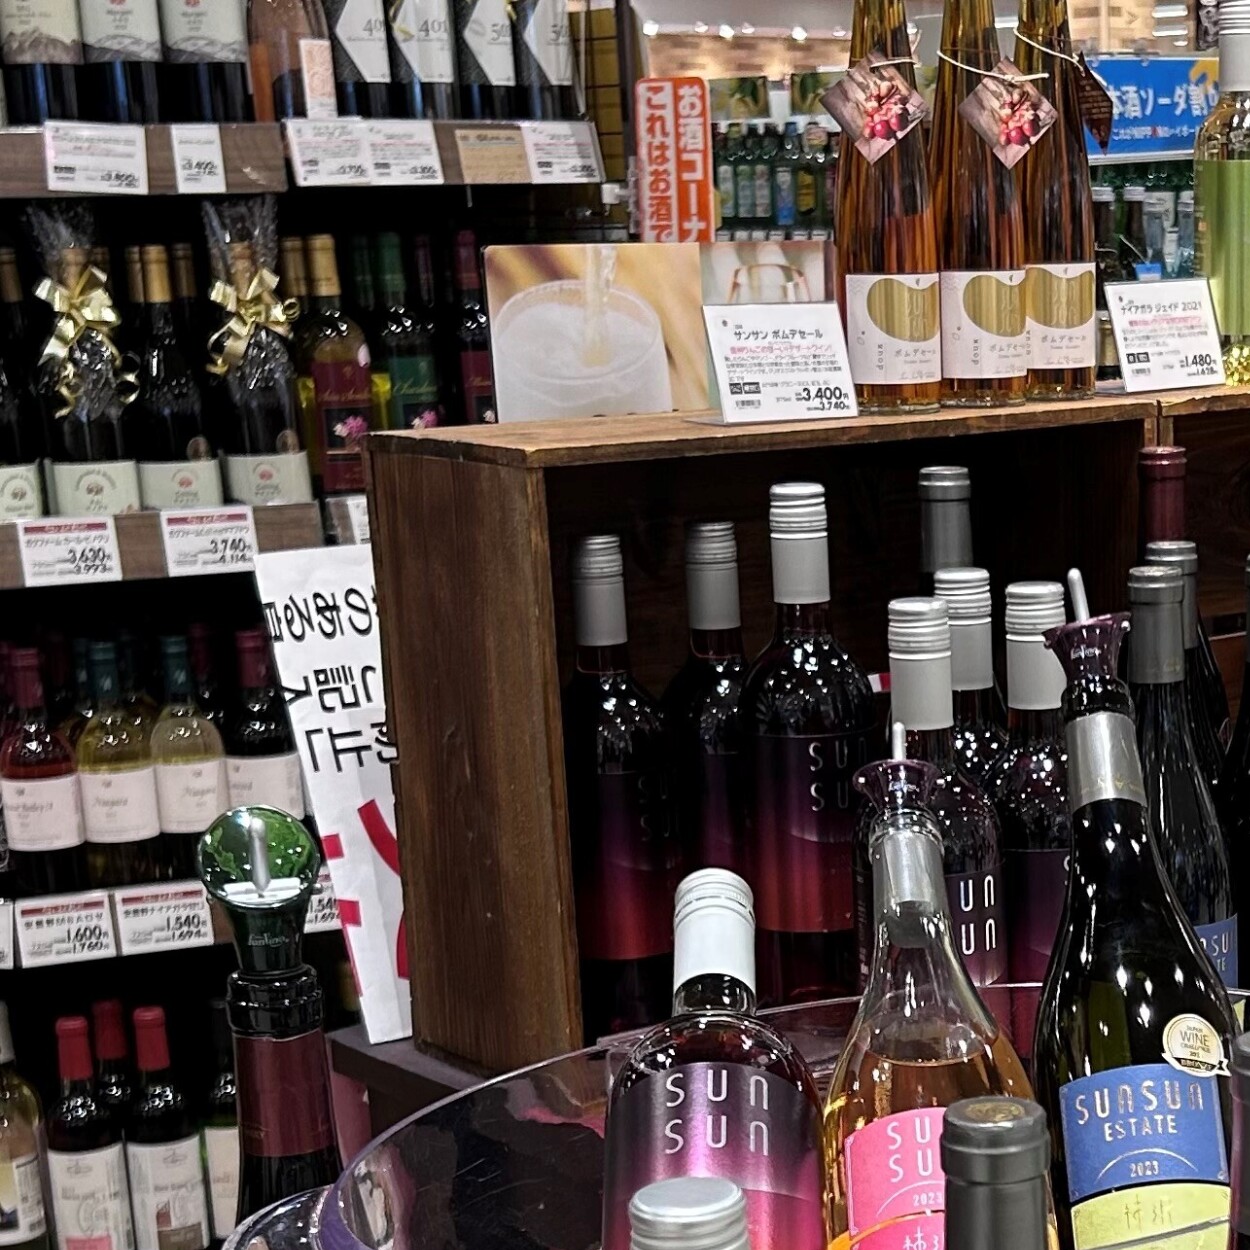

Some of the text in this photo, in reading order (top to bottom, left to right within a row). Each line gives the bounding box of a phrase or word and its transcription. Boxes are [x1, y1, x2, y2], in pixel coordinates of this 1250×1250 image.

[1179, 1029, 1211, 1048] WINE
[1104, 1113, 1178, 1142] ESTATE
[1129, 1160, 1160, 1178] 2023
